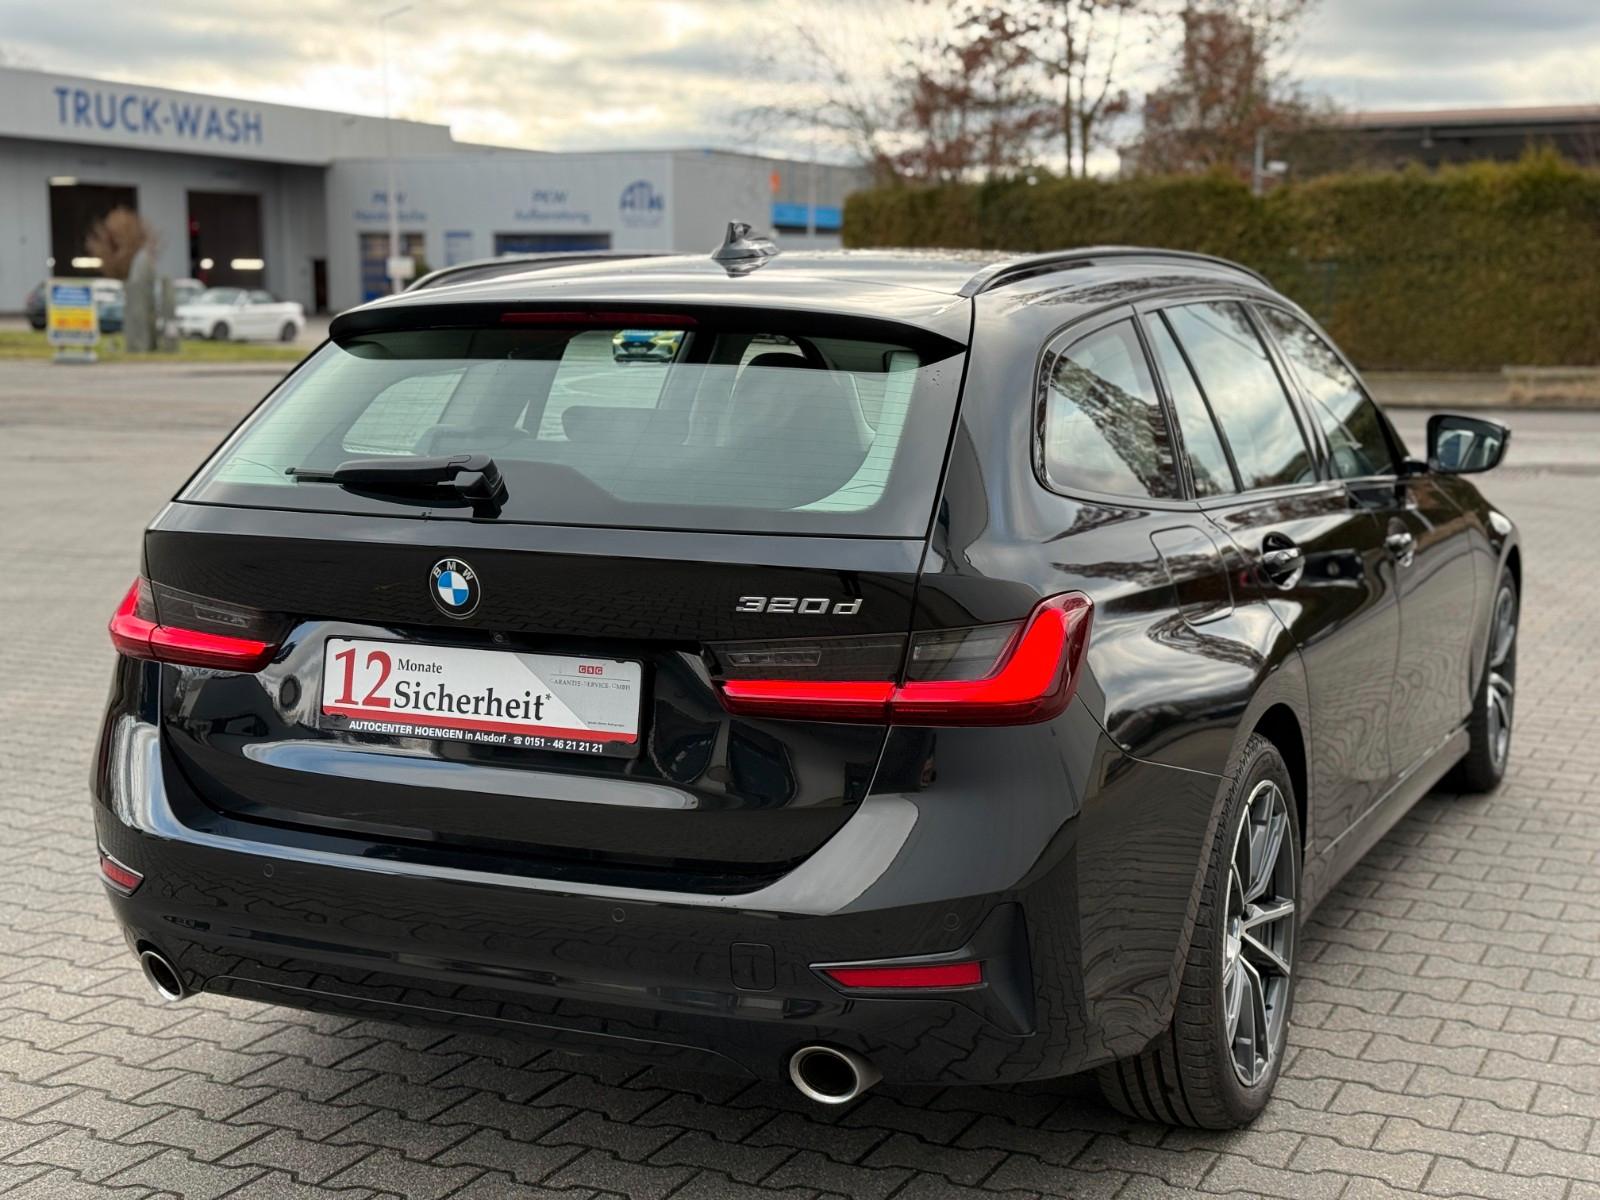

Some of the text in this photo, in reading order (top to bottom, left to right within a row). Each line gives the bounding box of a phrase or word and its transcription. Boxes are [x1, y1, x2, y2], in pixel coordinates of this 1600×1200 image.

[54, 86, 263, 143] TRUCK-WASH
[432, 560, 474, 581] BMW
[735, 596, 863, 615] 320d
[334, 647, 392, 709] 12
[397, 658, 443, 674] Monate
[348, 720, 412, 735] AUTOCENTER
[414, 726, 463, 740] HOENGEN
[465, 731, 473, 740] in
[474, 732, 507, 743] Alsdorf
[525, 736, 545, 747] 0151
[552, 739, 564, 749] 46
[566, 741, 576, 750] 21
[579, 742, 590, 752] 21
[592, 743, 603, 753] 21
